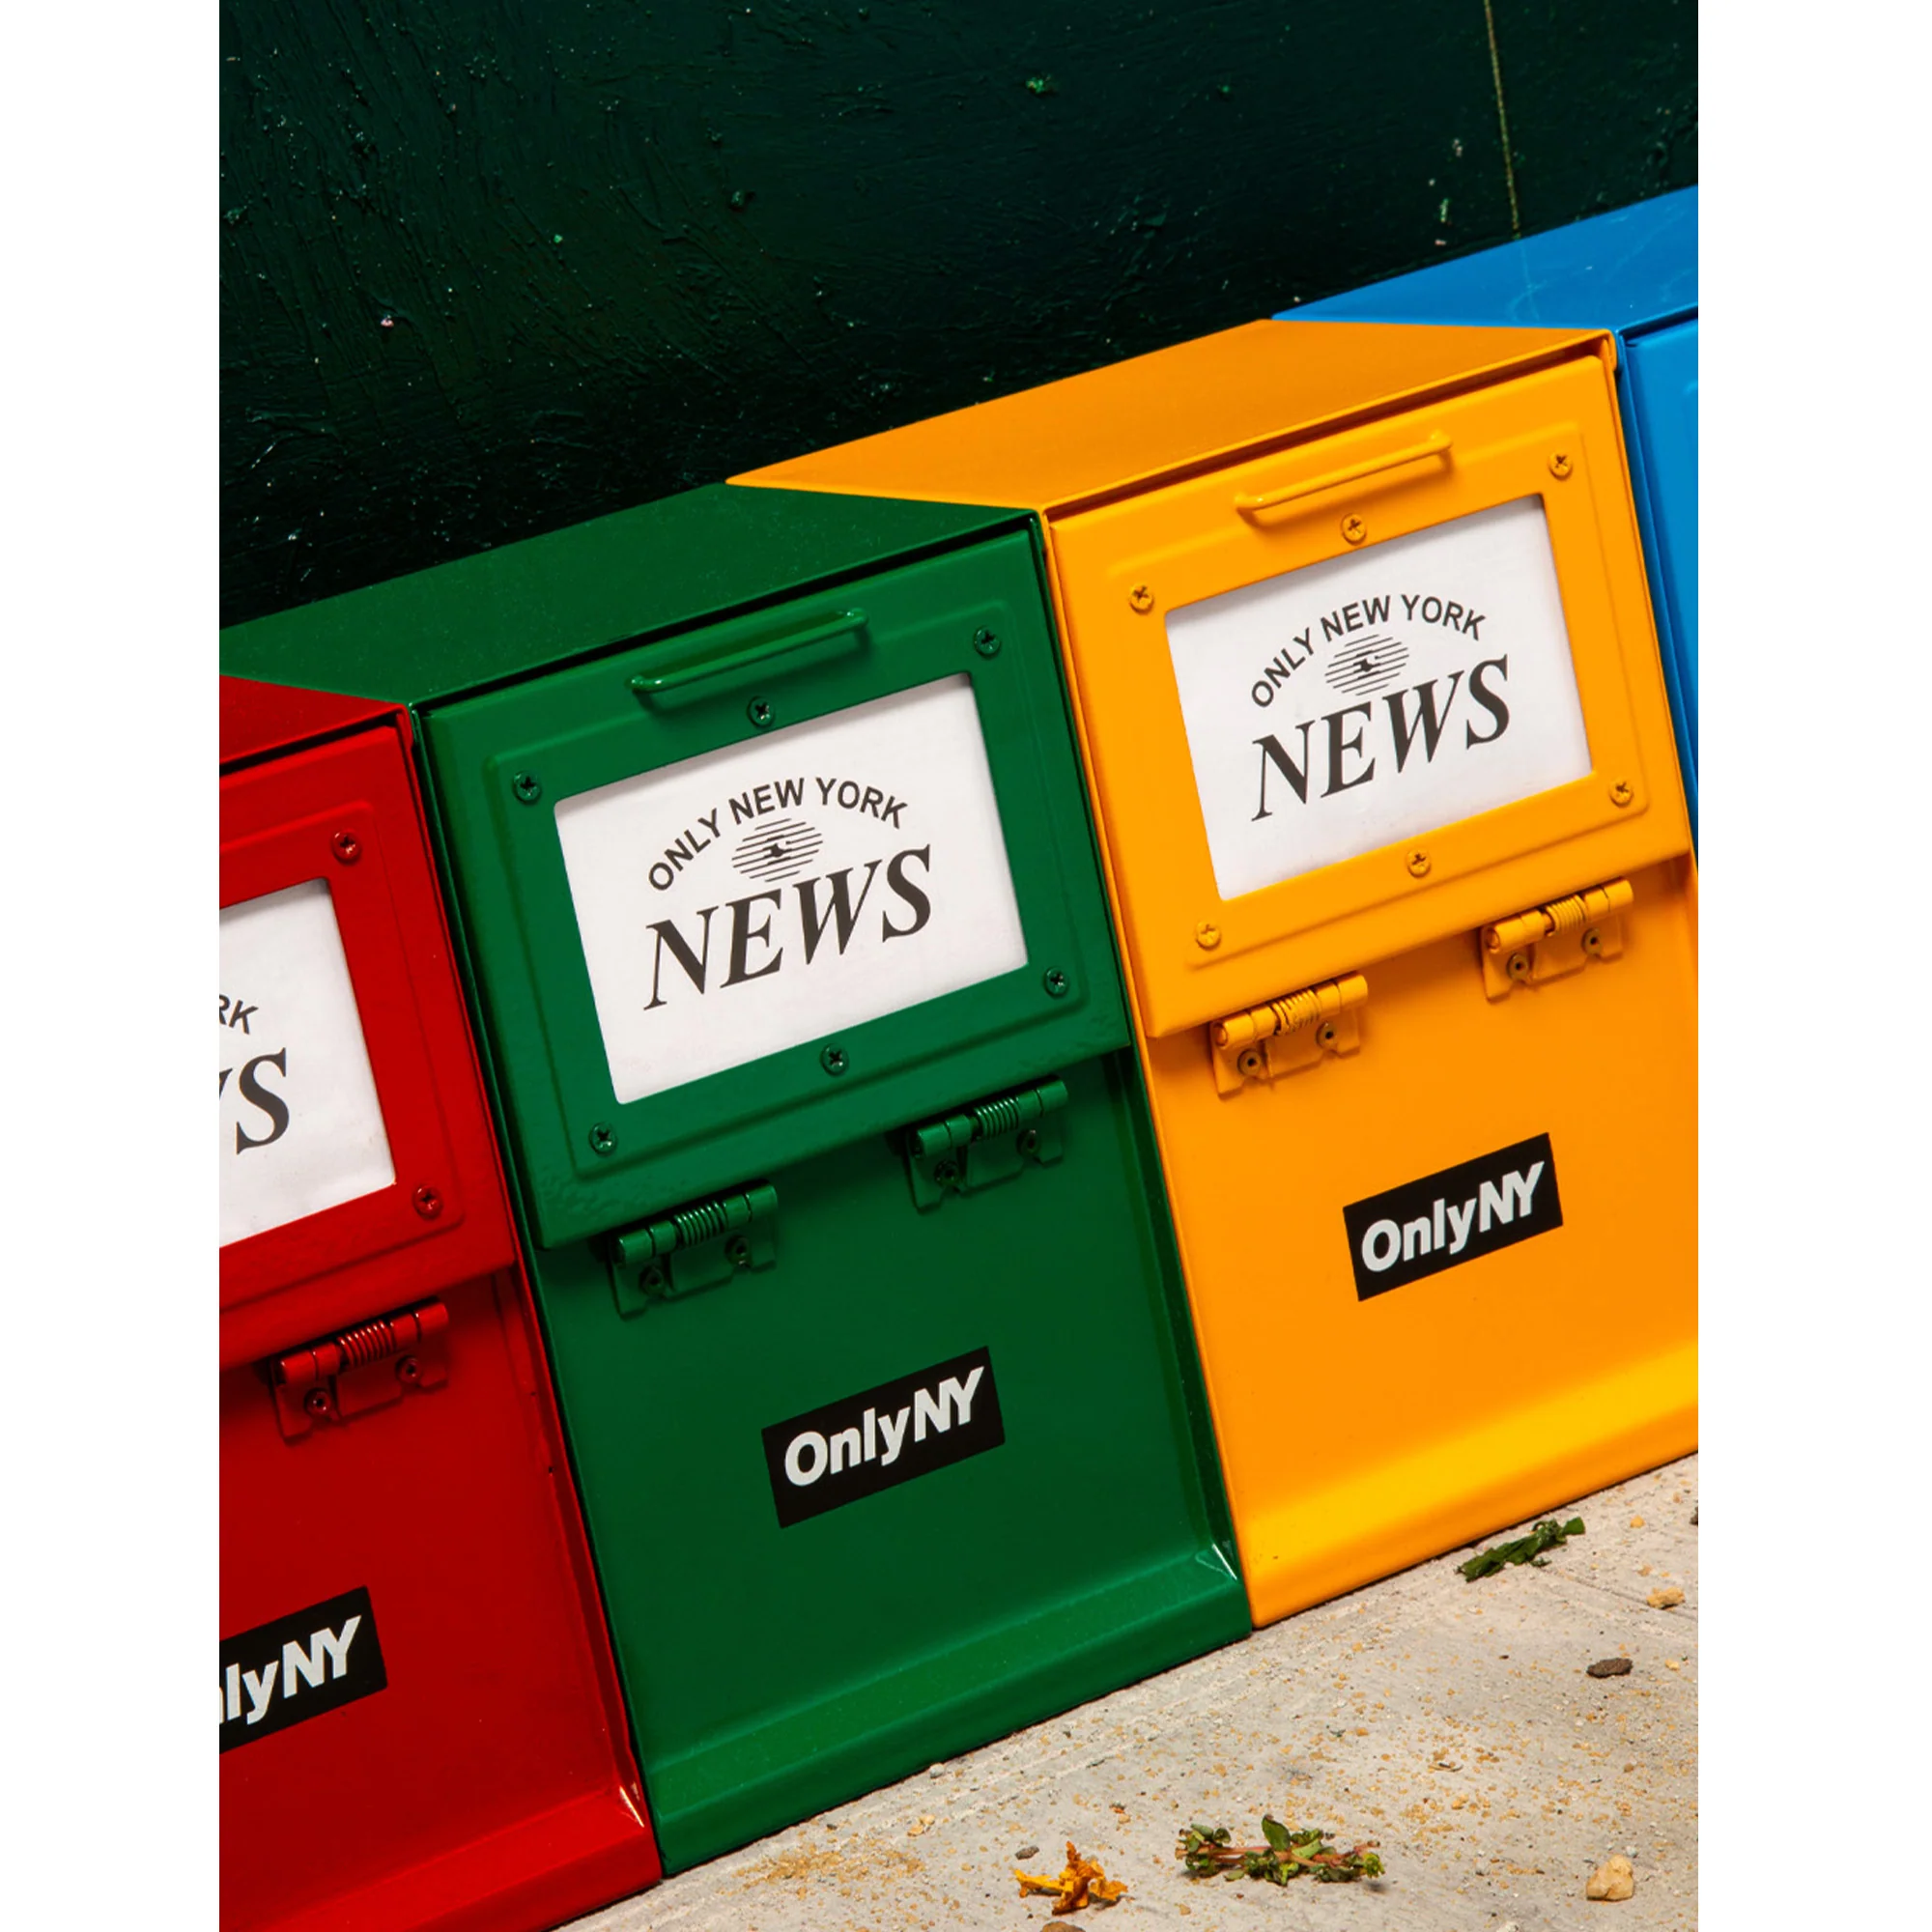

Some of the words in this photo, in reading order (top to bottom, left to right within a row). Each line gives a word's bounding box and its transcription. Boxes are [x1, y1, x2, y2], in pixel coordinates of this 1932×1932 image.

[1252, 627, 1314, 708] ONLY
[1321, 595, 1391, 642] NEW
[1401, 594, 1487, 640] YORK
[1251, 654, 1510, 822] NEWS
[648, 809, 721, 891] ONLY
[728, 778, 805, 825] NEW
[816, 778, 908, 829] YORK
[643, 844, 931, 1010] NEWS
[219, 1047, 290, 1155] S
[1361, 1161, 1544, 1271] OnlyNY
[784, 1366, 983, 1486] OnlyNY
[219, 1615, 362, 1725] lyNY
